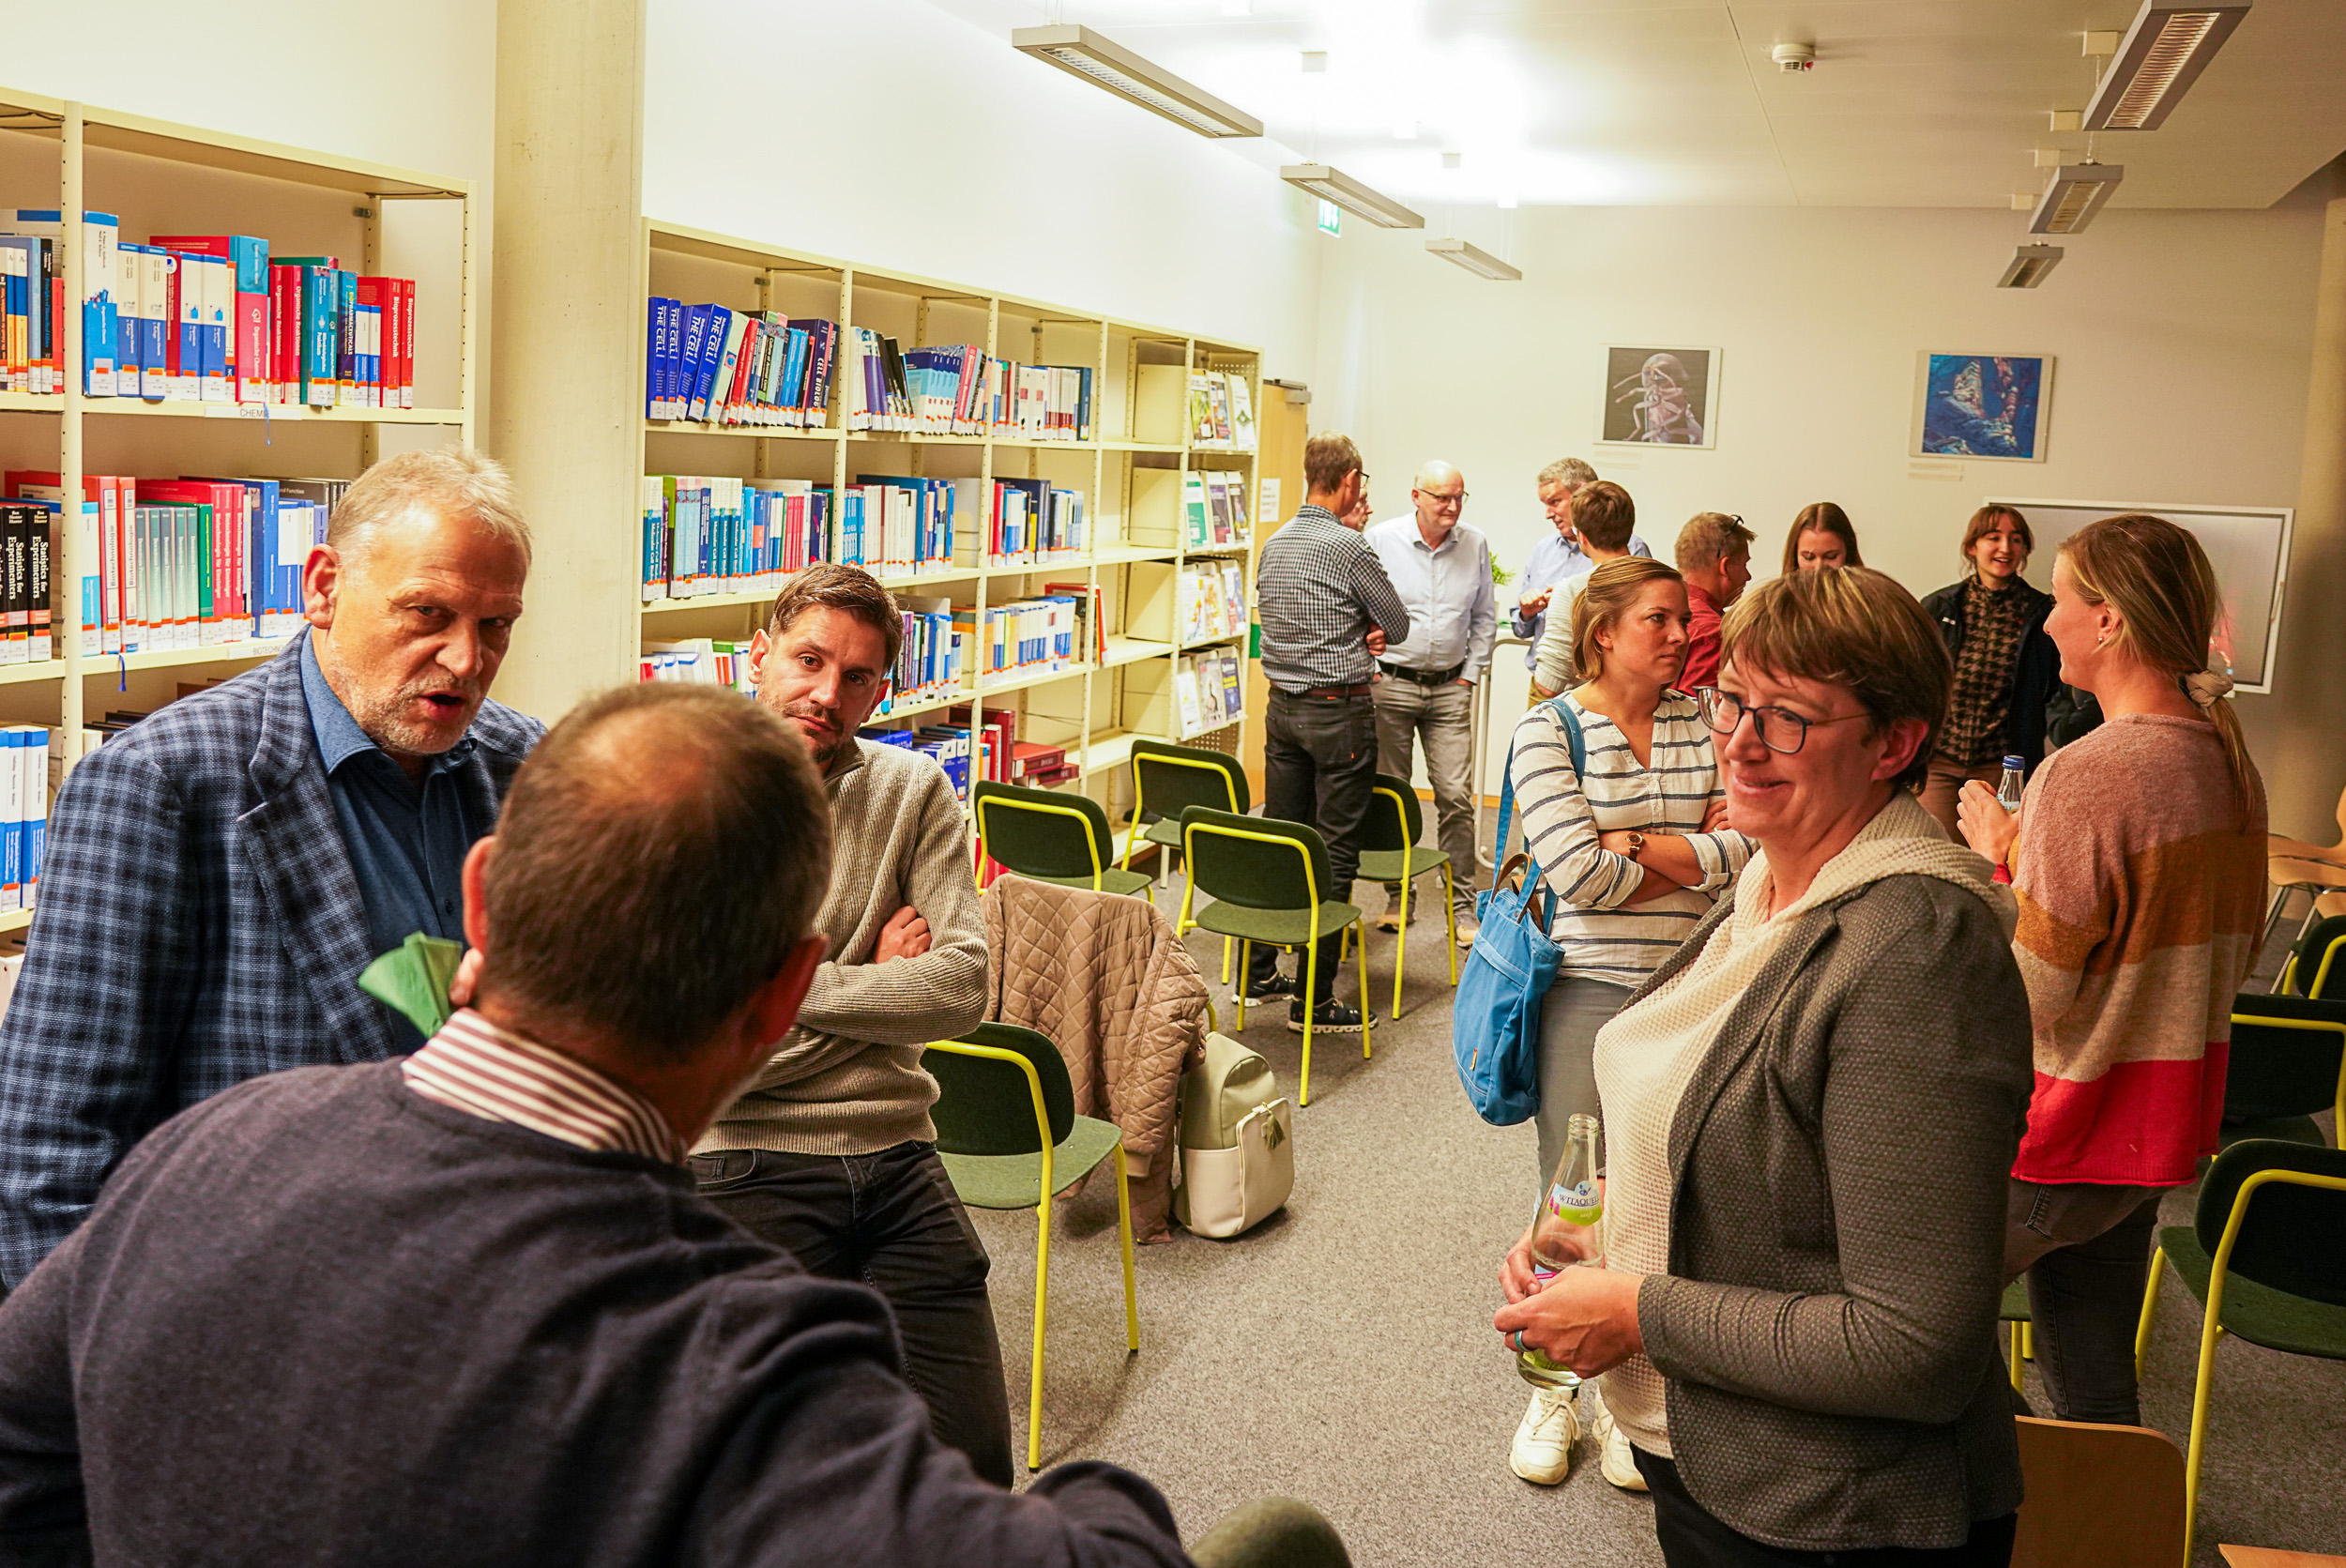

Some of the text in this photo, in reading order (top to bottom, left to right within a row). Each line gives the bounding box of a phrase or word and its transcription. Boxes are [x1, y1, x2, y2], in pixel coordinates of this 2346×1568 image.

[686, 316, 702, 357] THE CELL
[706, 315, 723, 357] THE CELL
[240, 408, 269, 418] CHEMI
[6, 537, 17, 600] Experimenters
[15, 542, 24, 580] Statistics
[30, 536, 41, 599] Experimenters
[39, 542, 49, 580] Statistics
